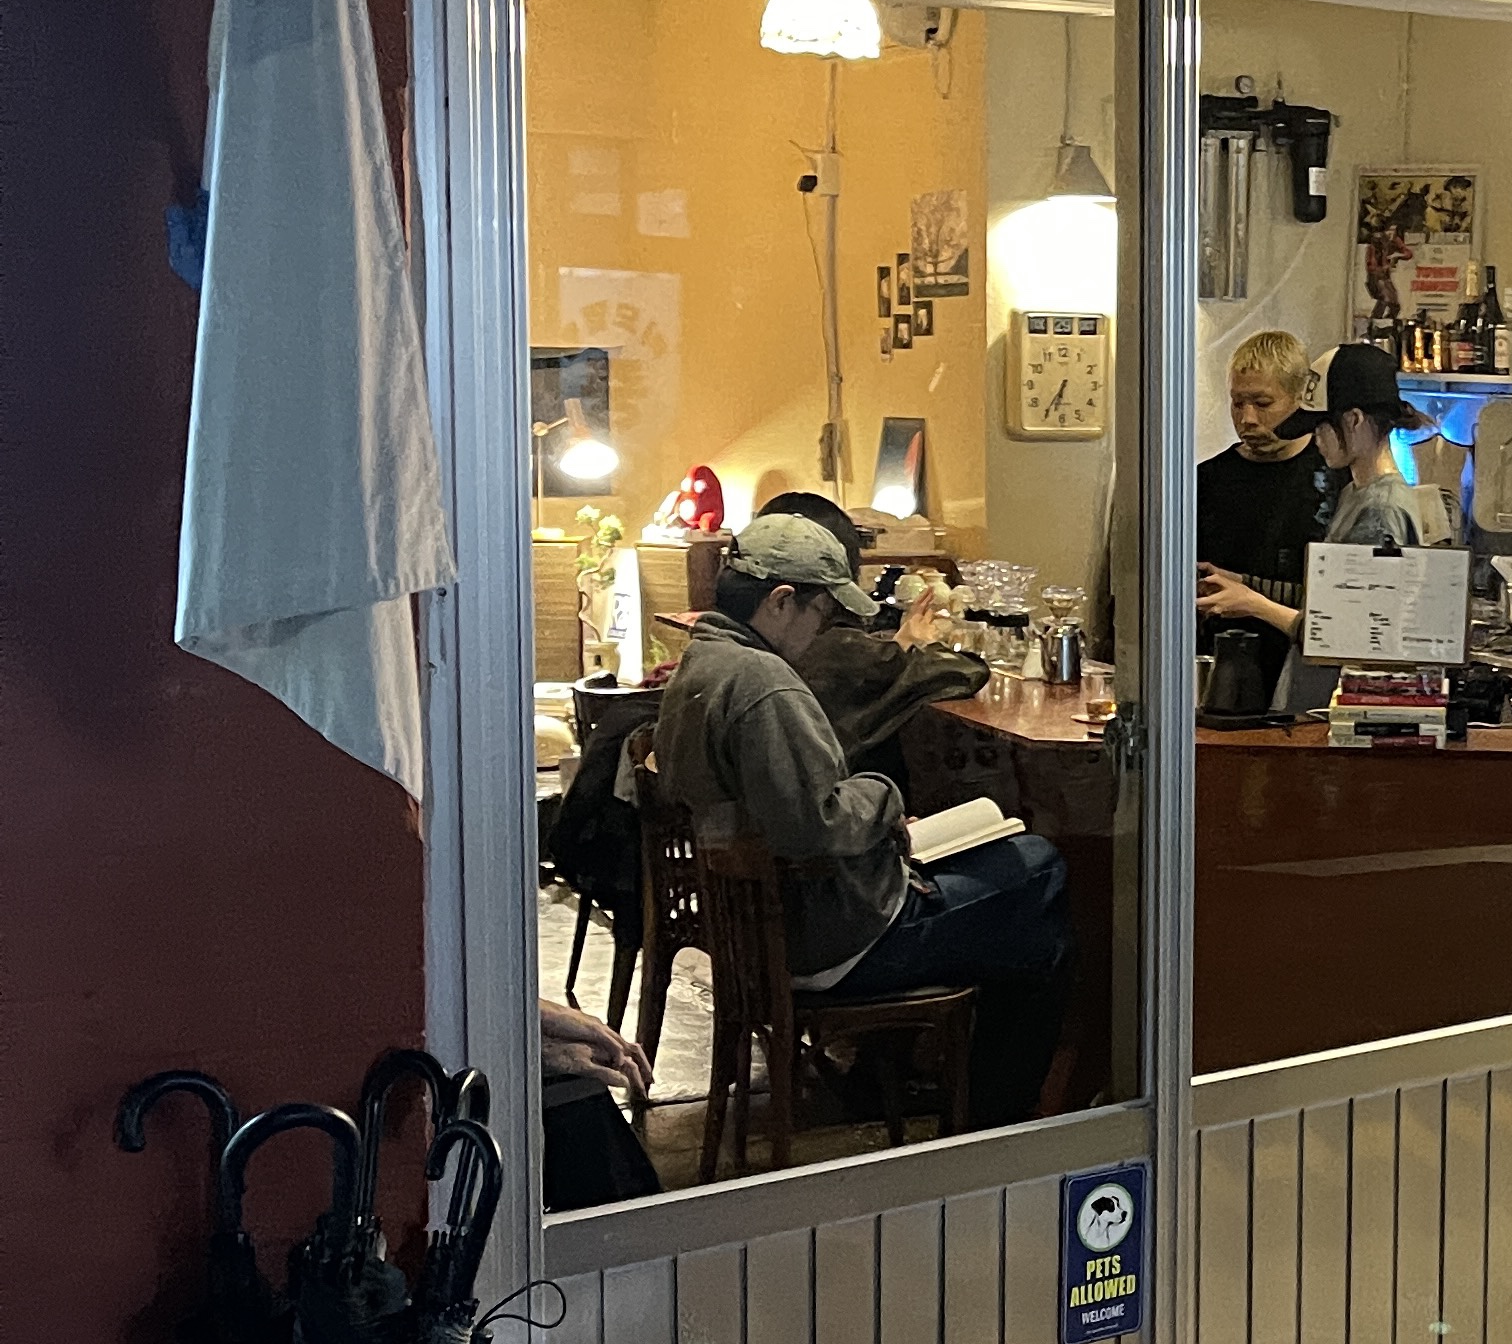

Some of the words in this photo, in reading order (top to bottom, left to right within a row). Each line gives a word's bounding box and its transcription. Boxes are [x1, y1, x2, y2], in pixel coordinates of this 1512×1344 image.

[1086, 1254, 1121, 1281] PETS
[1069, 1274, 1136, 1308] ALLOWED
[1081, 1303, 1126, 1325] WELCOME
